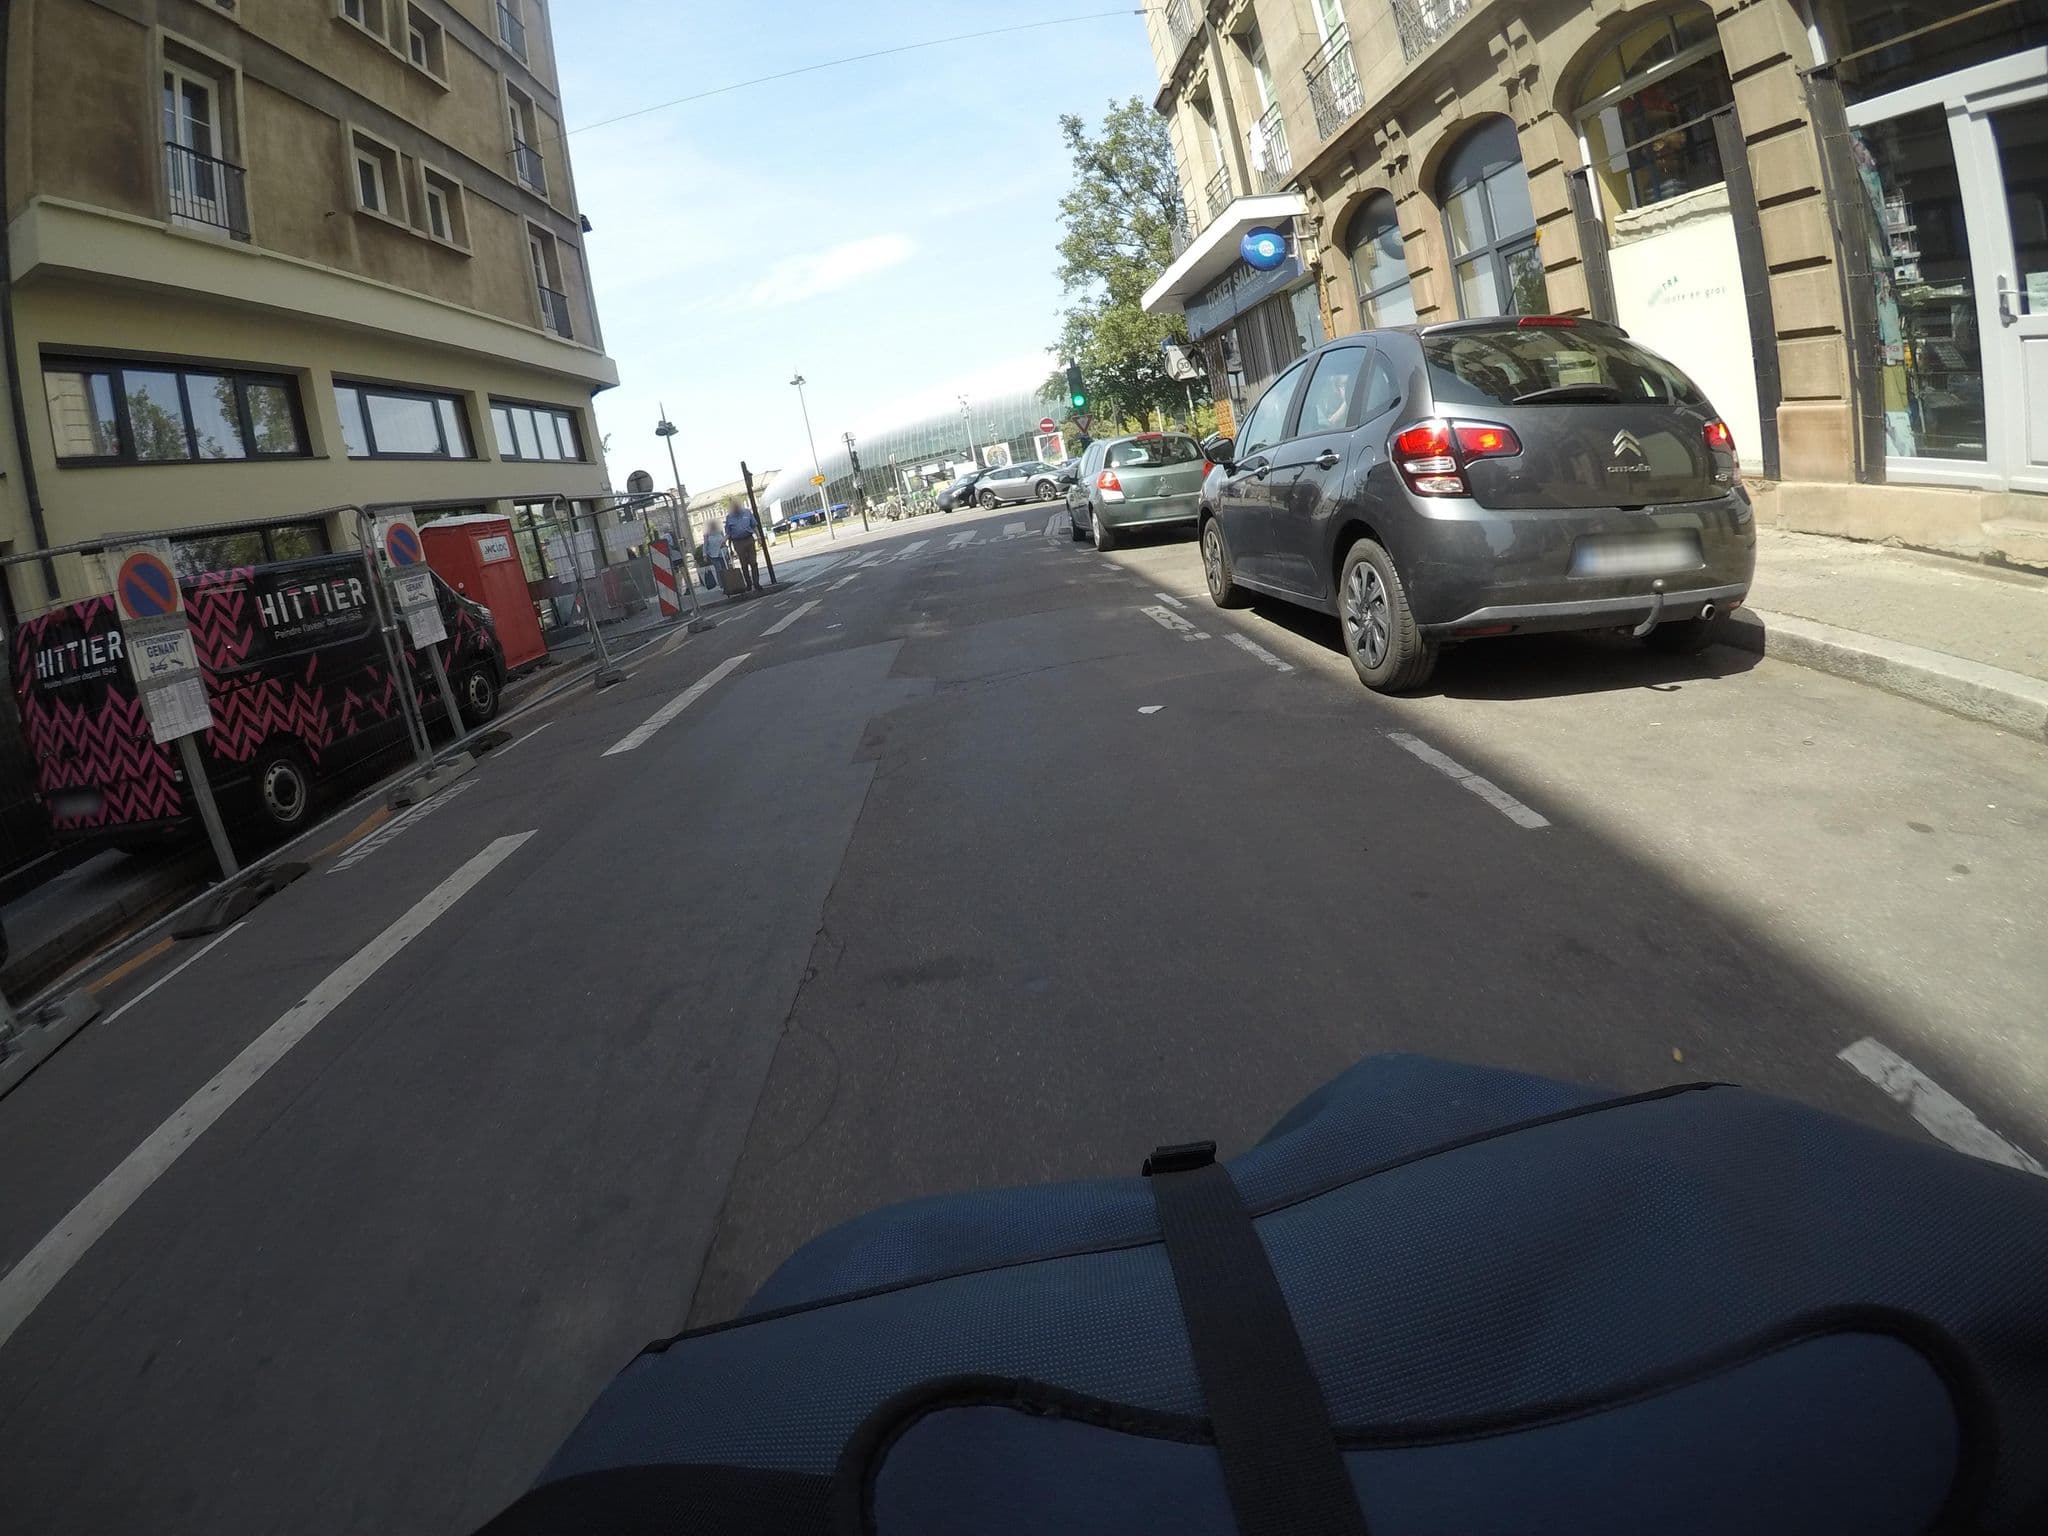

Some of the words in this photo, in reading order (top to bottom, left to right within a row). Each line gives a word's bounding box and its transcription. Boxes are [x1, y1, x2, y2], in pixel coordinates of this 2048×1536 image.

[1179, 361, 1190, 370] 30
[256, 577, 367, 628] HITTIER
[35, 630, 124, 679] HITTIER
